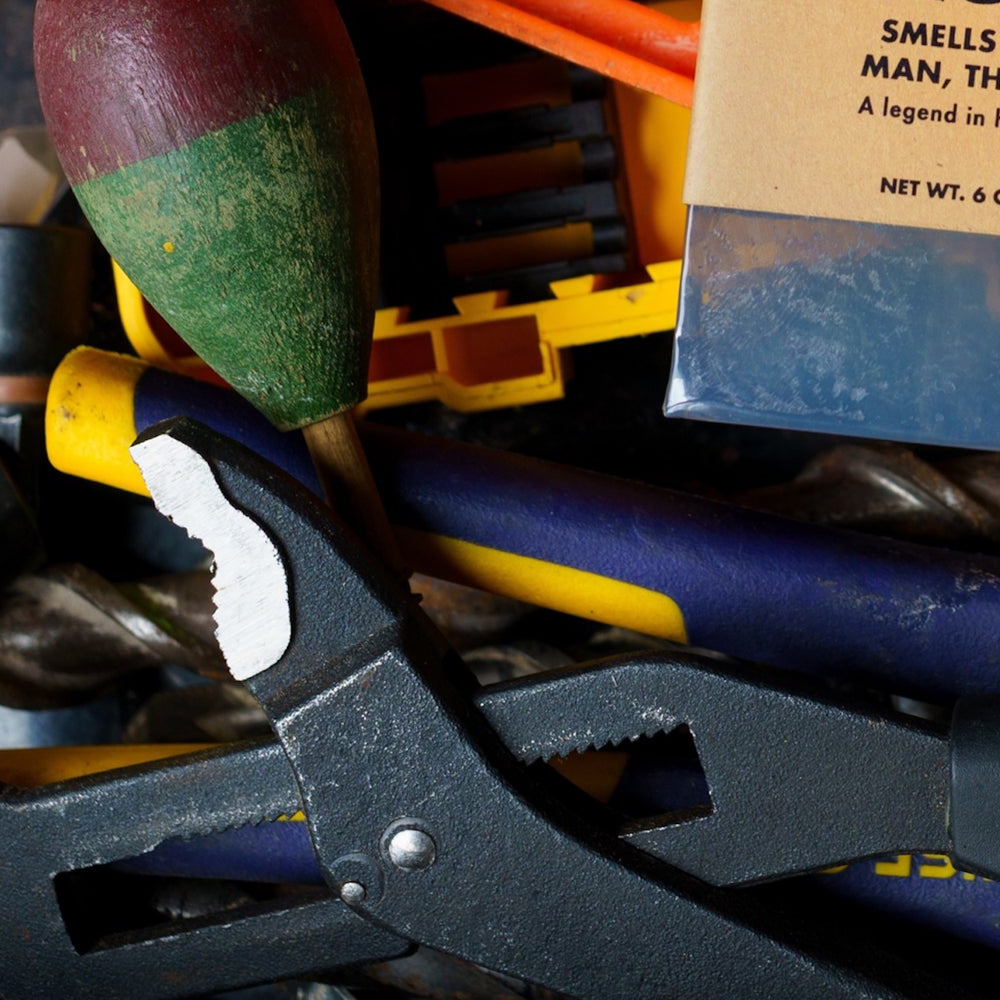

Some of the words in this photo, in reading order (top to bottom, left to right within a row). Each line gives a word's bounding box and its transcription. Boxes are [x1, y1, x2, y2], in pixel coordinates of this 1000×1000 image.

[881, 19, 997, 53] SMELLS
[861, 54, 952, 89] MAN,
[859, 98, 875, 115] A
[882, 96, 958, 129] legend
[966, 106, 986, 125] in
[880, 177, 922, 196] NET
[926, 180, 965, 202] WT.
[972, 186, 986, 203] 6
